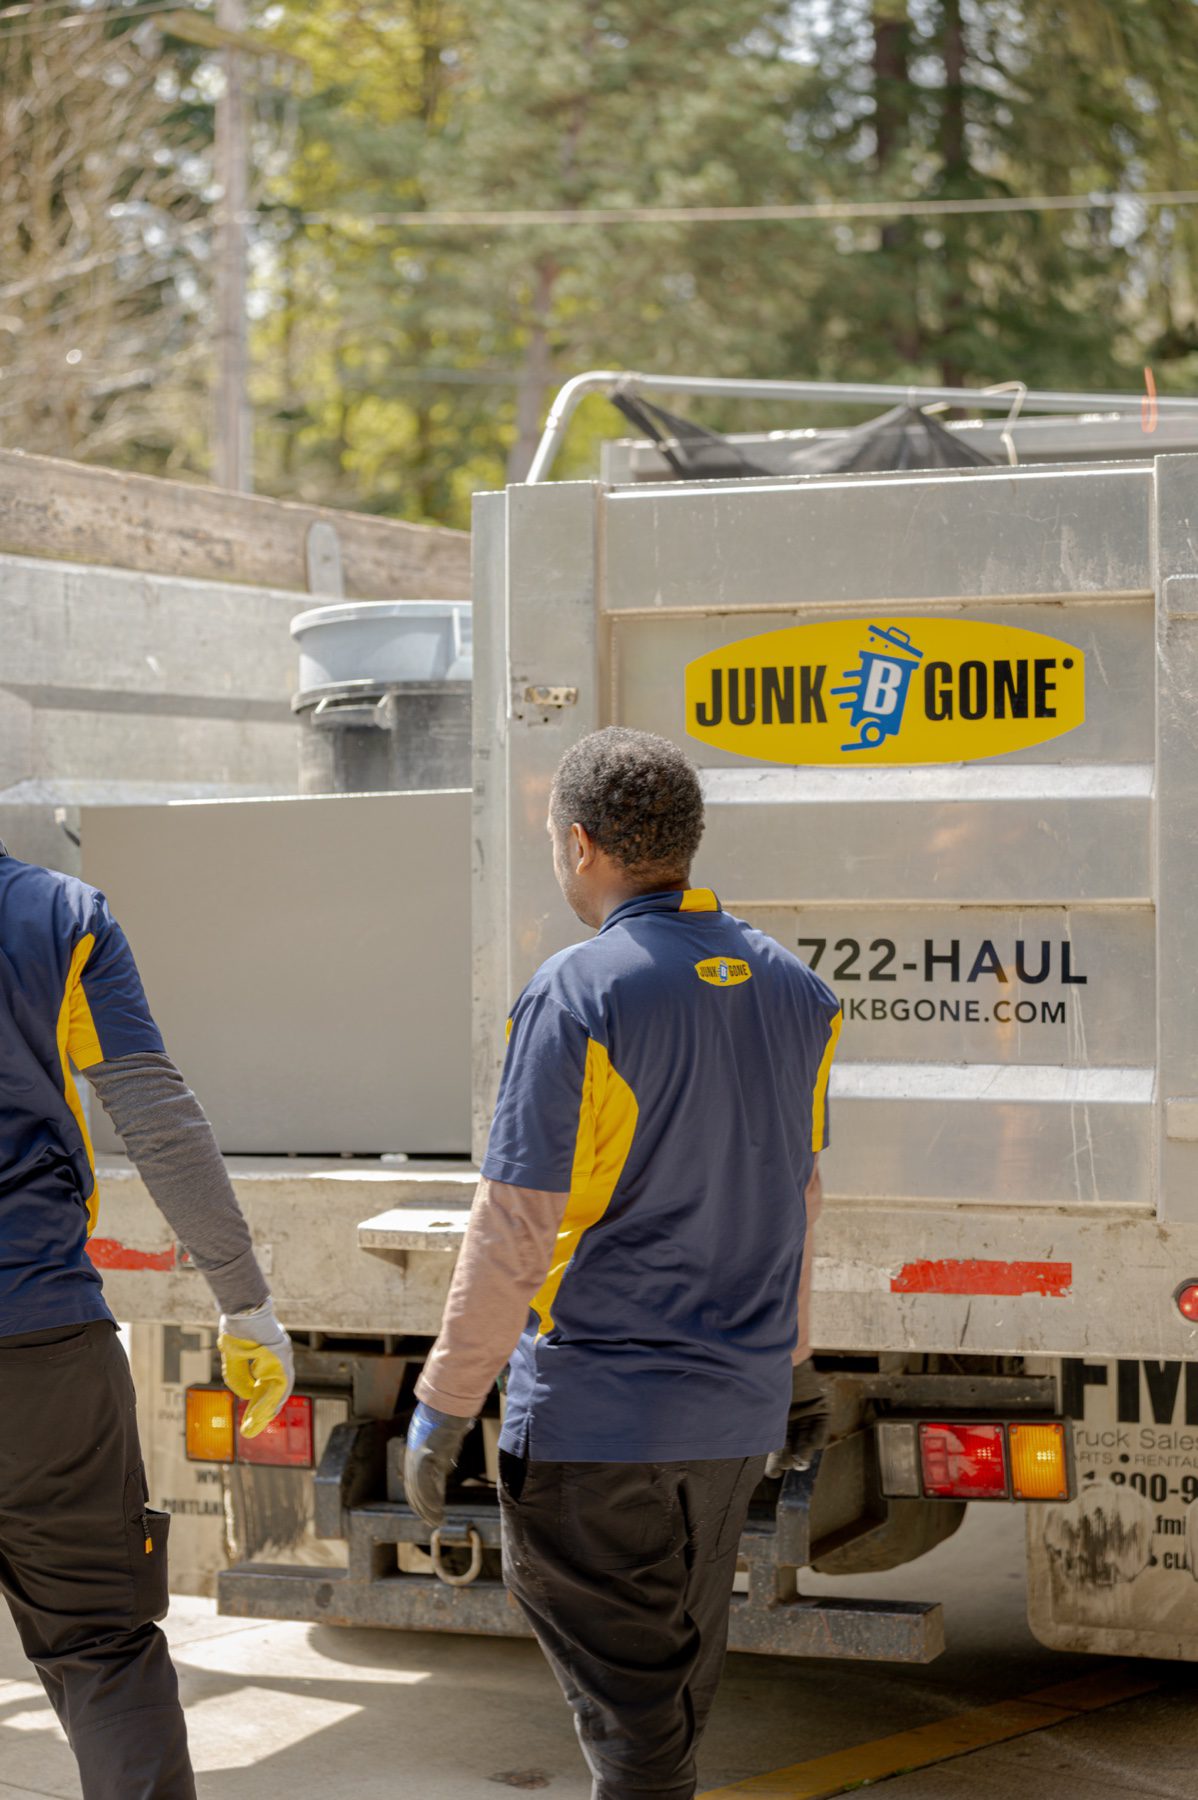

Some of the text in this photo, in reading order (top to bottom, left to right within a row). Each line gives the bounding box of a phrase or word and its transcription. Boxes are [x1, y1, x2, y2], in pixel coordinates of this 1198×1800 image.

[696, 658, 1057, 727] JUNK B GONE
[728, 964, 748, 977] GONE
[797, 937, 1088, 985] 722-HAUL
[840, 999, 1066, 1024] KBGONE.COM
[1073, 1426, 1130, 1448] ruck
[1074, 1451, 1114, 1465] RTS
